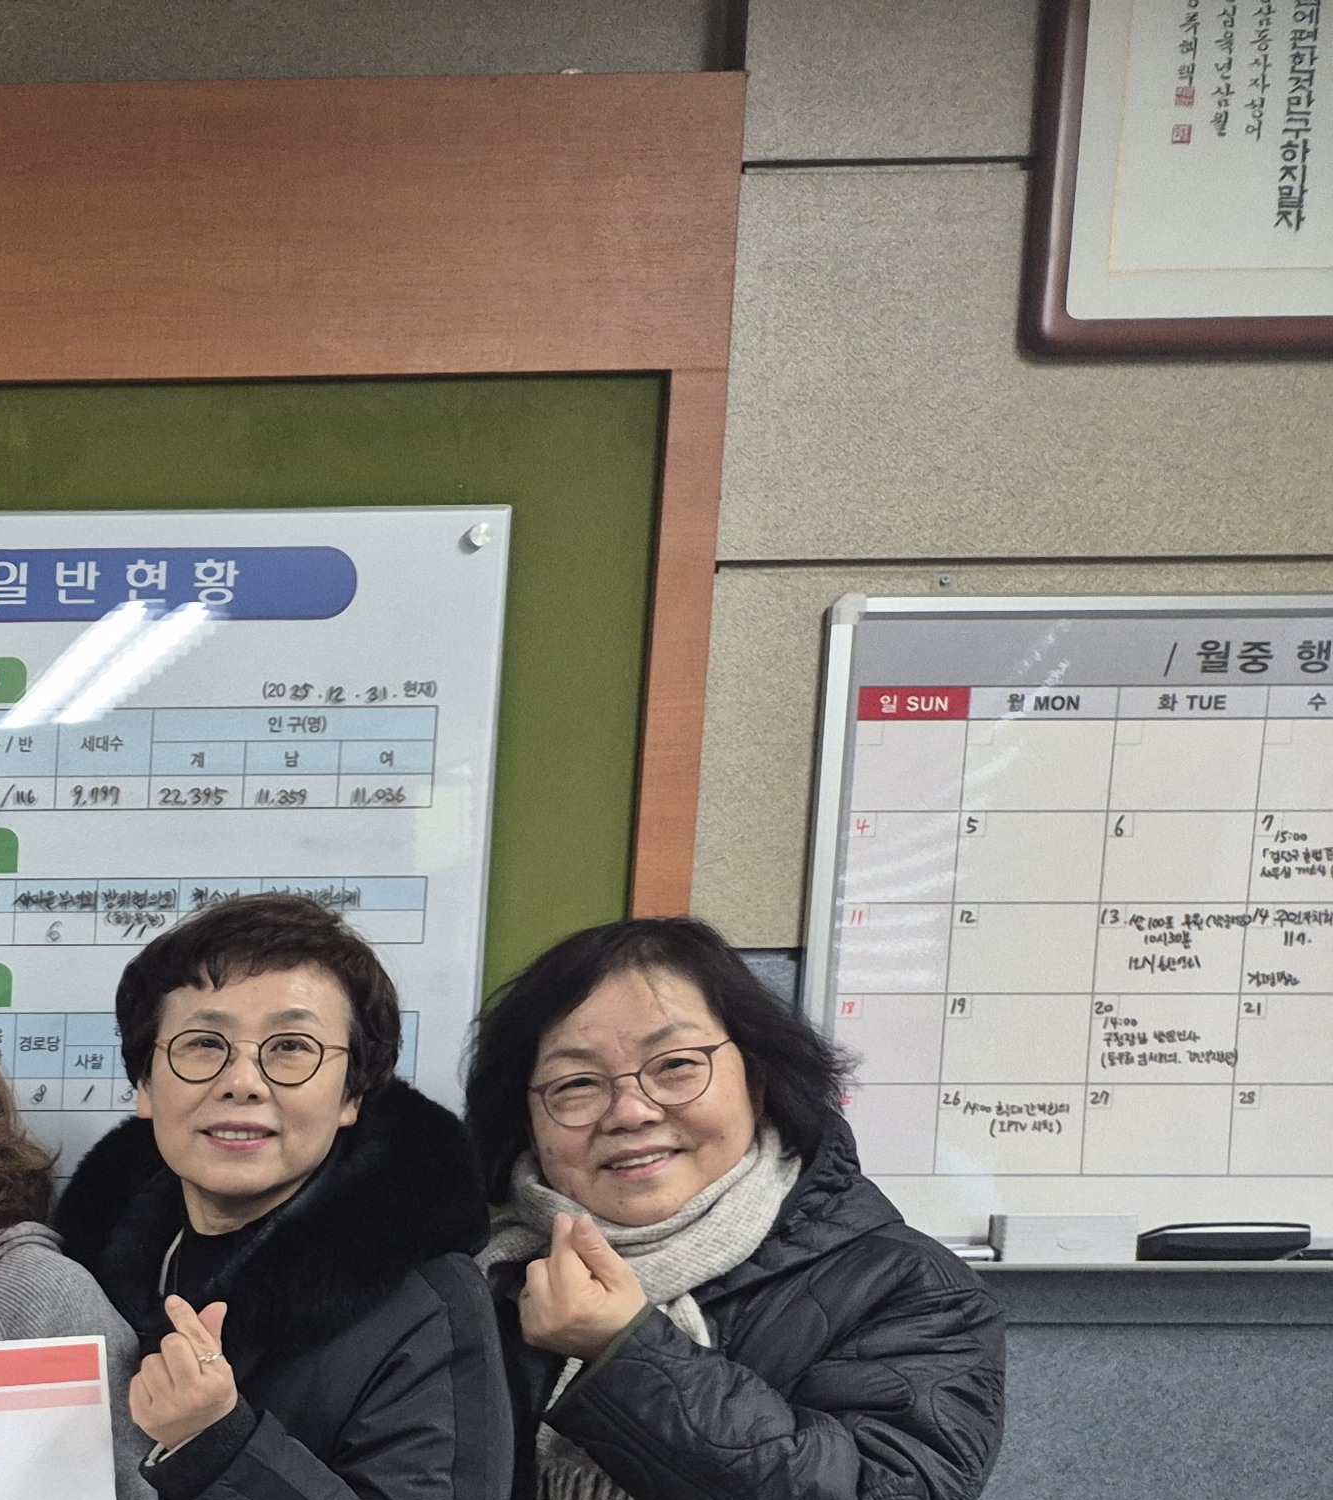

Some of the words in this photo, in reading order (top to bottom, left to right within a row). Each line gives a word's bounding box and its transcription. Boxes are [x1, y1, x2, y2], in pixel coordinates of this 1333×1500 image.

[1197, 640, 1273, 674] 월중
[403, 680, 437, 699] 현재)
[880, 695, 899, 713] 일
[906, 695, 949, 712] SUN
[1007, 694, 1026, 712] 월
[1034, 695, 1080, 711] MON
[1157, 694, 1178, 711] 화
[1186, 695, 1227, 711] TUE
[1308, 694, 1327, 711] 수
[80, 735, 124, 753] 세대수
[191, 752, 205, 768] 계
[284, 751, 299, 768] 남
[379, 751, 394, 767] 여
[856, 818, 871, 835] 4
[966, 816, 979, 834] 5
[1115, 815, 1125, 837] 6
[1261, 815, 1274, 831] 7
[1274, 831, 1307, 843] 15:00
[850, 909, 862, 925] 11
[960, 910, 976, 924] 12
[47, 921, 63, 942] 6
[841, 1002, 855, 1015] 18
[950, 998, 966, 1015] 19
[1094, 1001, 1113, 1015] 20
[1243, 1002, 1261, 1016] 21
[1103, 1017, 1138, 1030] 14:00
[19, 1036, 60, 1052] 경로당
[75, 1054, 104, 1070] 사찰
[942, 1091, 961, 1106] 26
[1090, 1090, 1110, 1105] 27
[1239, 1091, 1256, 1105] 28
